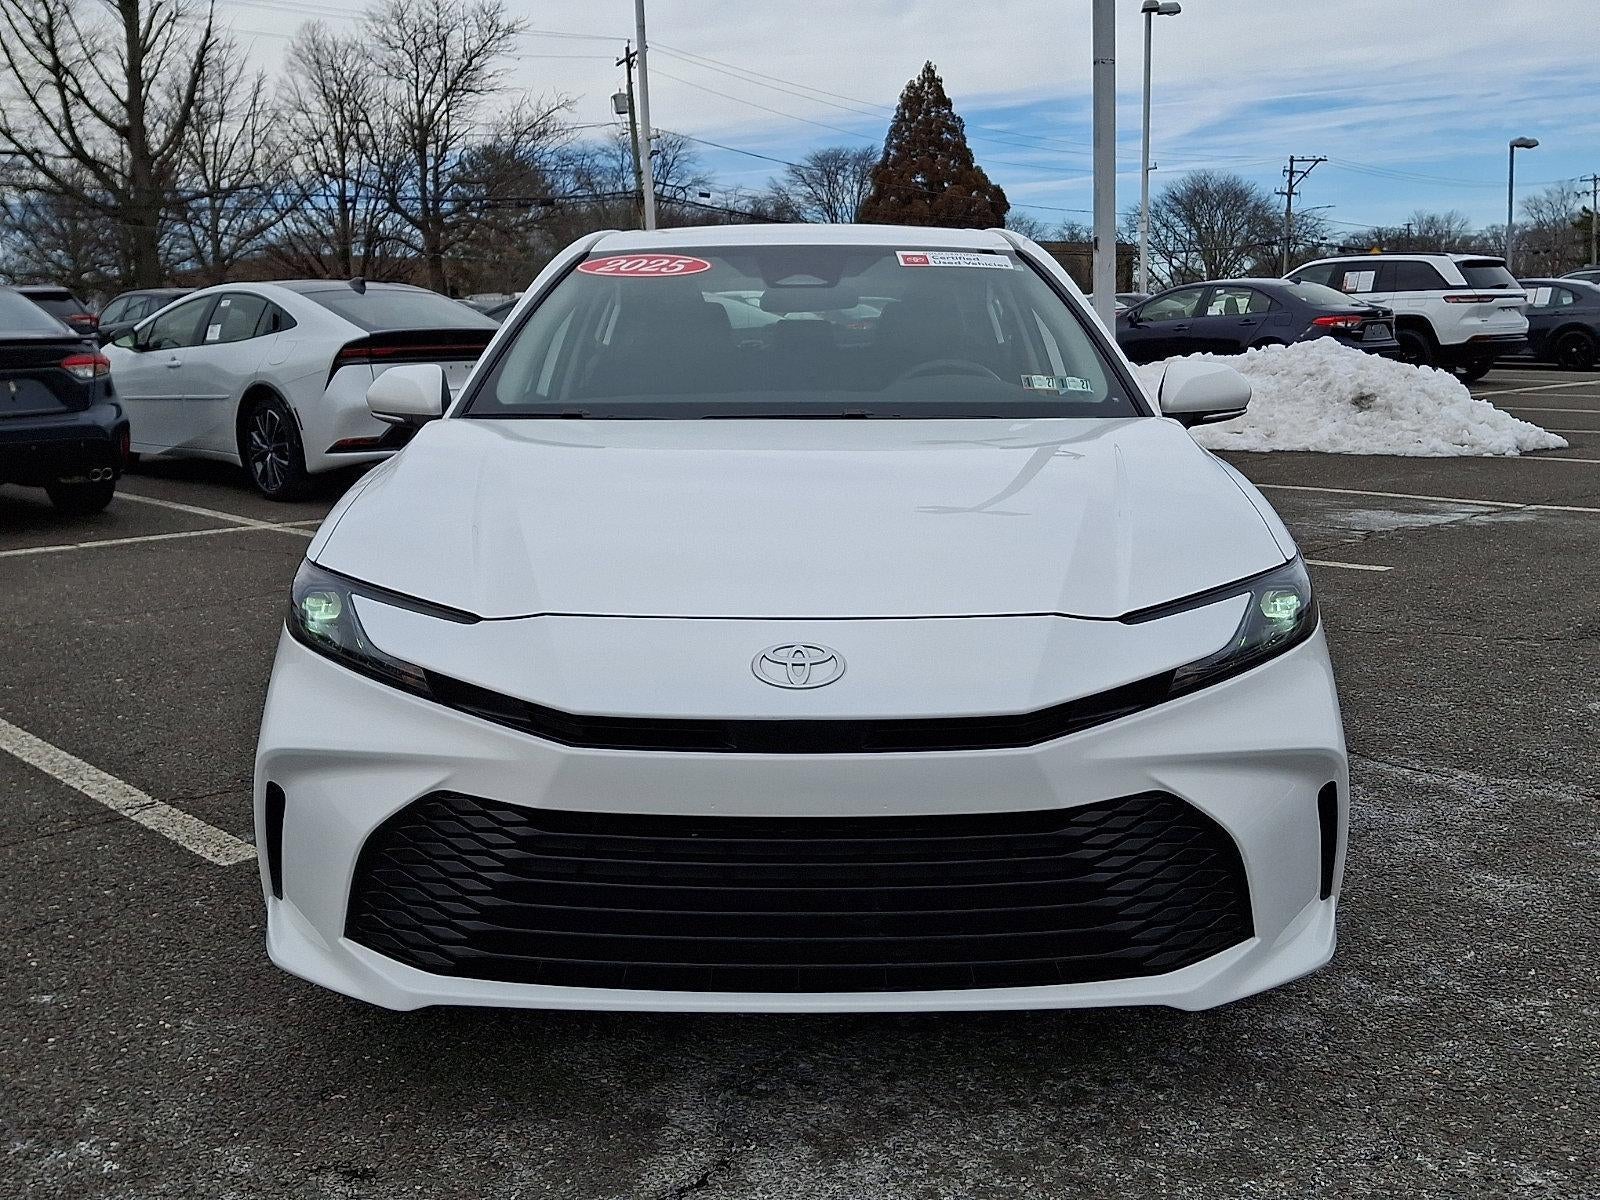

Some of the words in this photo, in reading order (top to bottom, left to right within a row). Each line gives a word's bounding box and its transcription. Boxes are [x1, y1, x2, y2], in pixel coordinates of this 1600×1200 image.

[596, 258, 692, 272] 2025
[964, 260, 1009, 268] Vehicles
[1045, 377, 1055, 388] 27
[1080, 379, 1089, 390] 27
